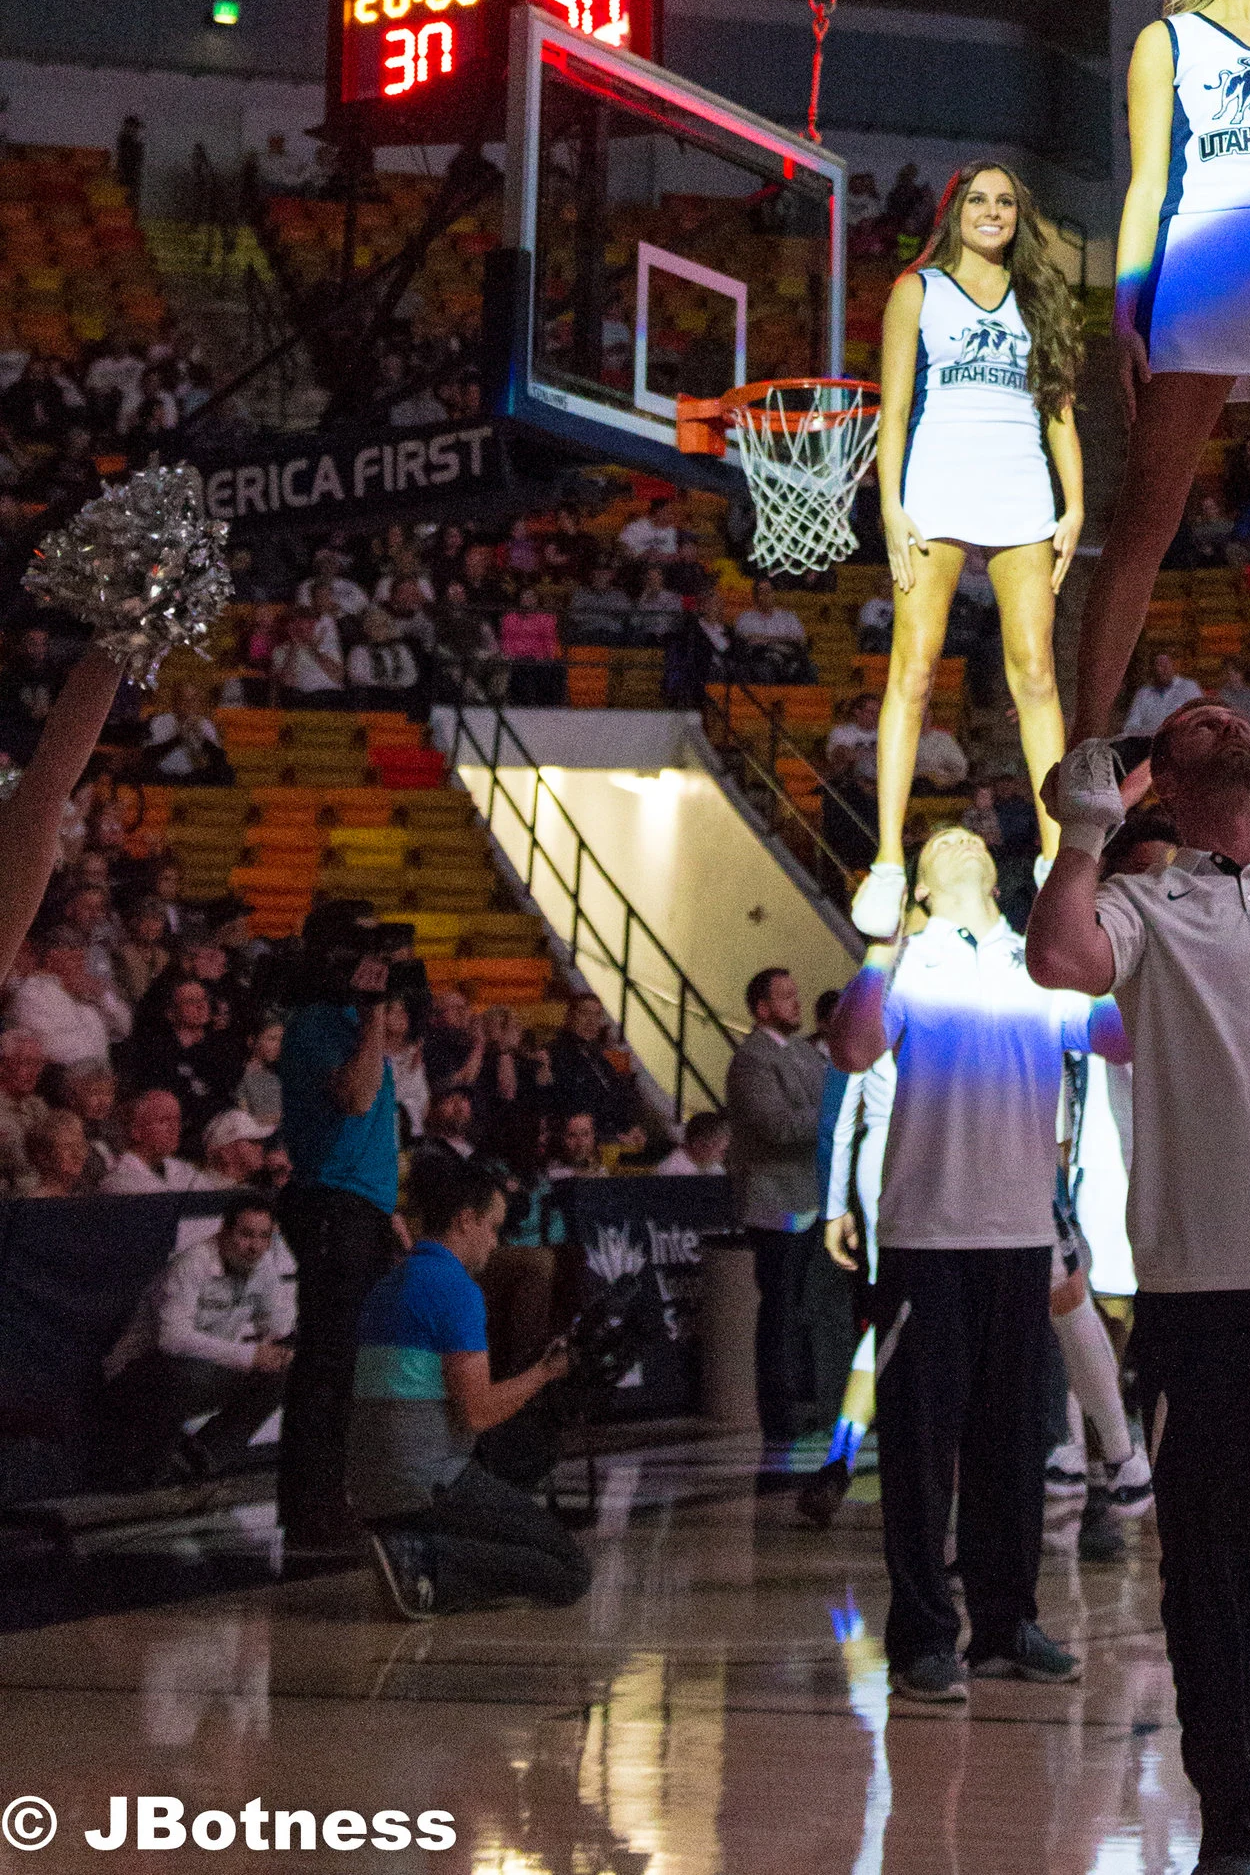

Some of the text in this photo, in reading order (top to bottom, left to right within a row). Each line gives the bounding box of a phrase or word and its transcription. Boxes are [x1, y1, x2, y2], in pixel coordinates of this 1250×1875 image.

[941, 365, 985, 385] UTAH
[196, 426, 494, 519] ERICA FIRST
